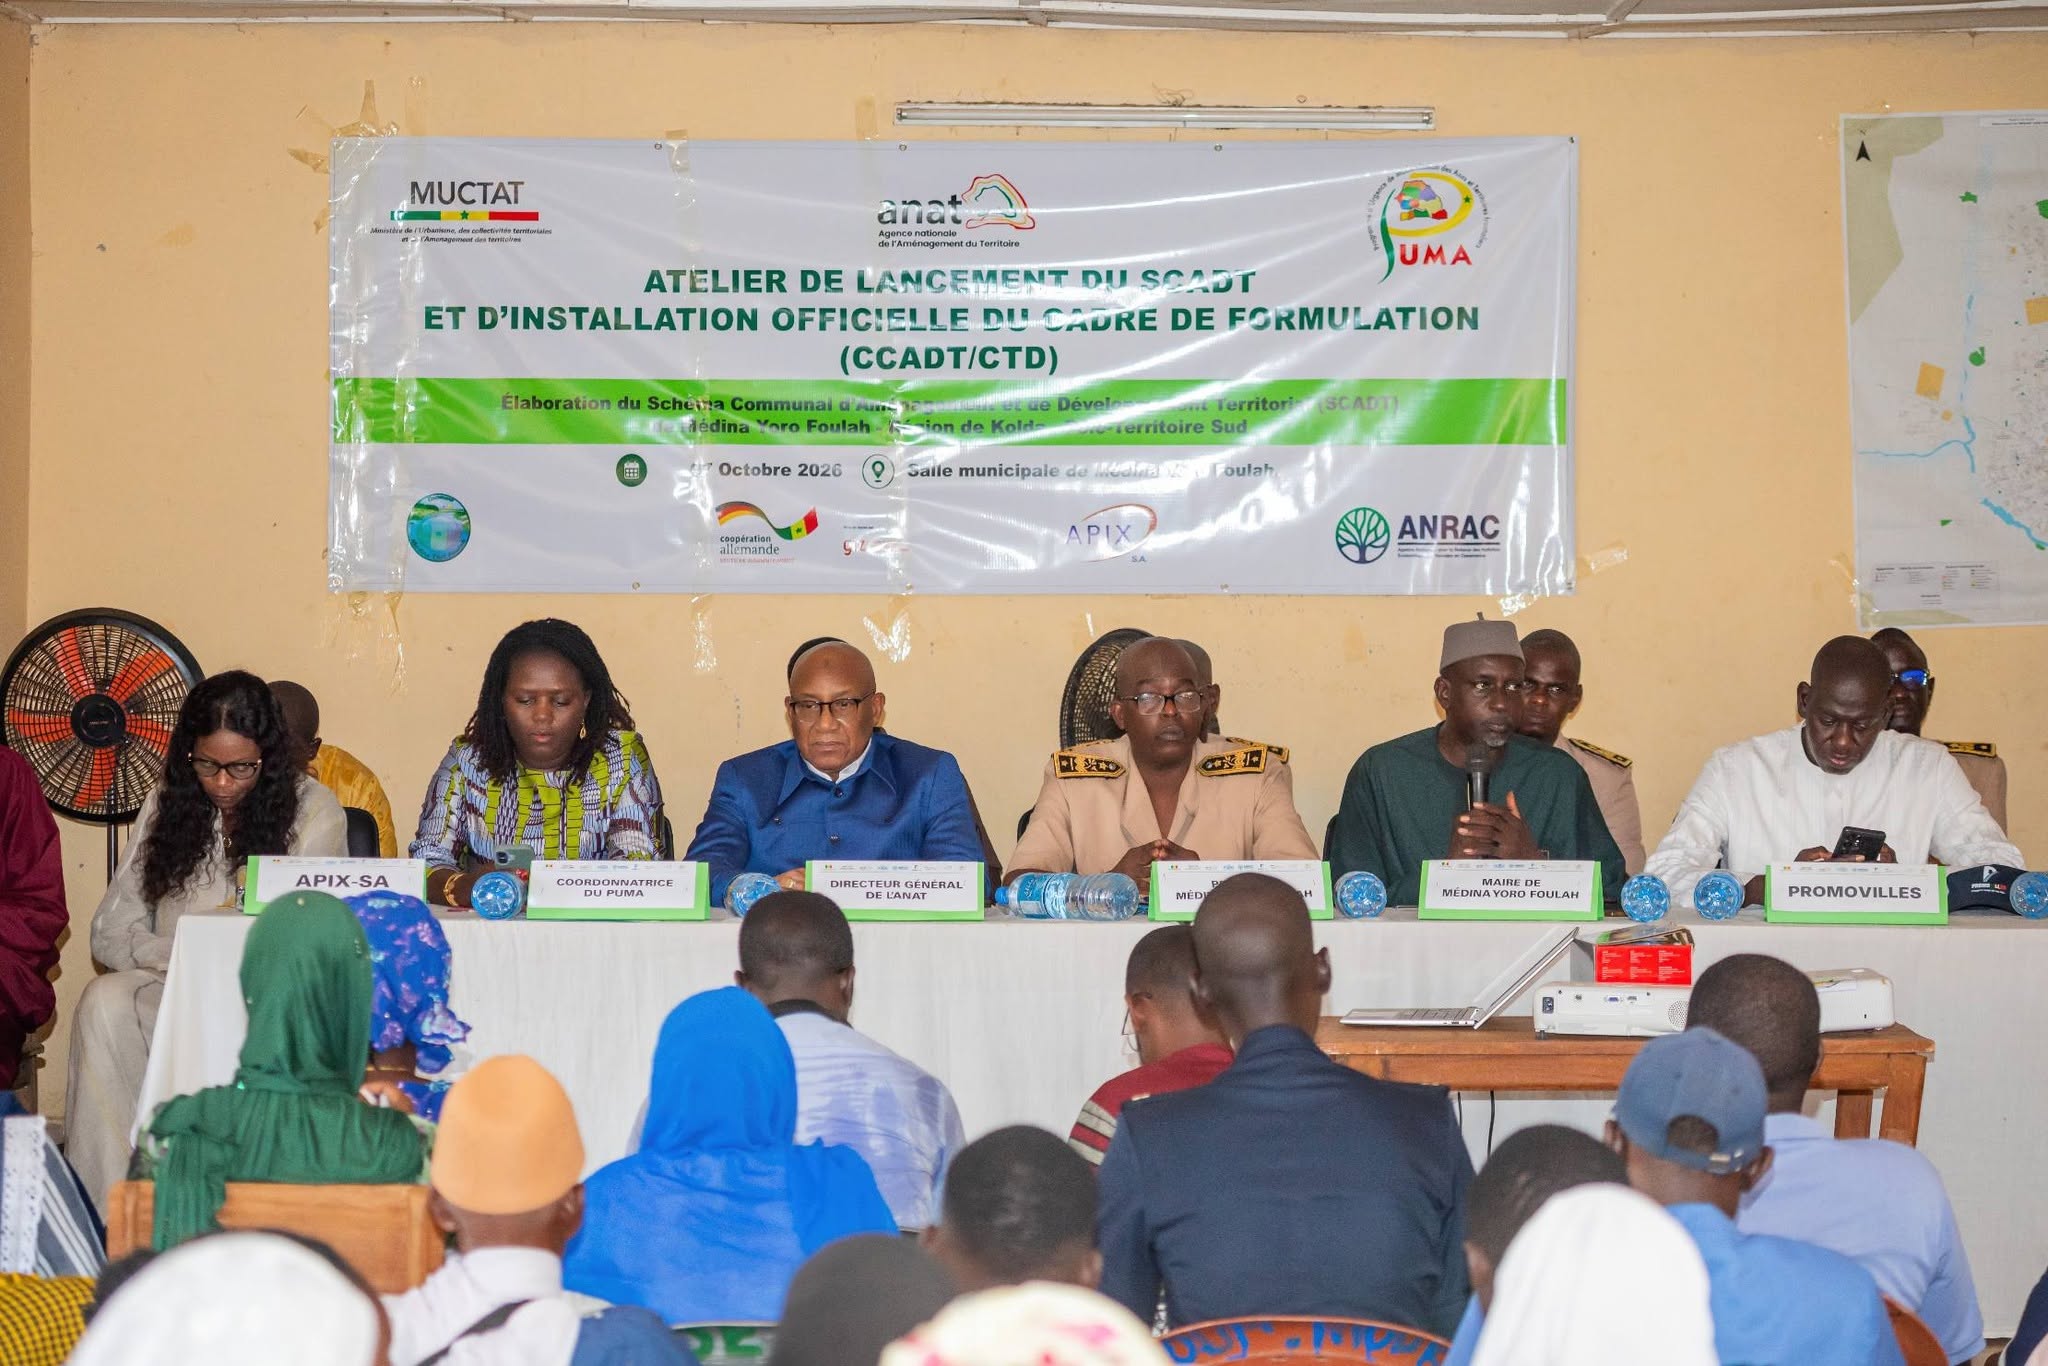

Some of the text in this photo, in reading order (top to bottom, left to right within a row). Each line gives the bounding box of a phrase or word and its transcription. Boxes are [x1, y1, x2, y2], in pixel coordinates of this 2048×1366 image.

[410, 181, 524, 205] MUCTAT
[878, 194, 962, 225] anat
[404, 226, 413, 234] de
[458, 226, 471, 234] des
[512, 227, 553, 235] territoriales
[878, 229, 957, 239] Agence nationale
[878, 239, 1020, 250] de l'Aménagement du Territoire
[643, 269, 1256, 294] ATELIER DE LANCEMENT DU SCADT
[424, 306, 1480, 331] ET D'INSTALLATION OFFICIELLE DU CADRE DE FORMULATION
[839, 345, 1060, 376] (CCADT/CTD)
[501, 391, 611, 411] Élaboration
[617, 395, 641, 411] du
[730, 396, 832, 412] Communal
[1029, 397, 1051, 411] de
[1216, 395, 1310, 412] Territori
[1317, 395, 1400, 416] (SCADT)
[756, 419, 800, 434] Yoro
[807, 418, 870, 434] Foulah
[961, 418, 985, 433] de
[992, 418, 1045, 433] Kolda
[1211, 419, 1248, 434] Sud
[718, 462, 792, 477] Octobre
[797, 462, 843, 477] 2026
[907, 463, 953, 478] Salle
[958, 462, 1060, 481] municipale
[1397, 514, 1501, 540] ANRAC
[720, 534, 772, 544] coopération
[1066, 524, 1132, 545] APIX
[720, 543, 780, 555] allemande
[1131, 555, 1147, 563] SA
[295, 874, 390, 888] APIX-SA
[556, 878, 674, 888] COORDONNATRICE
[830, 879, 964, 889] DIRECTEUR GÉNÉRAL
[1482, 878, 1541, 887] MAIRE DE
[584, 889, 645, 898] DU PUMA
[866, 891, 928, 900] DE L'ANAT
[1442, 887, 1580, 899] MÉDINA YORO FOULAH
[1788, 885, 1922, 899] PROMOVILLES
